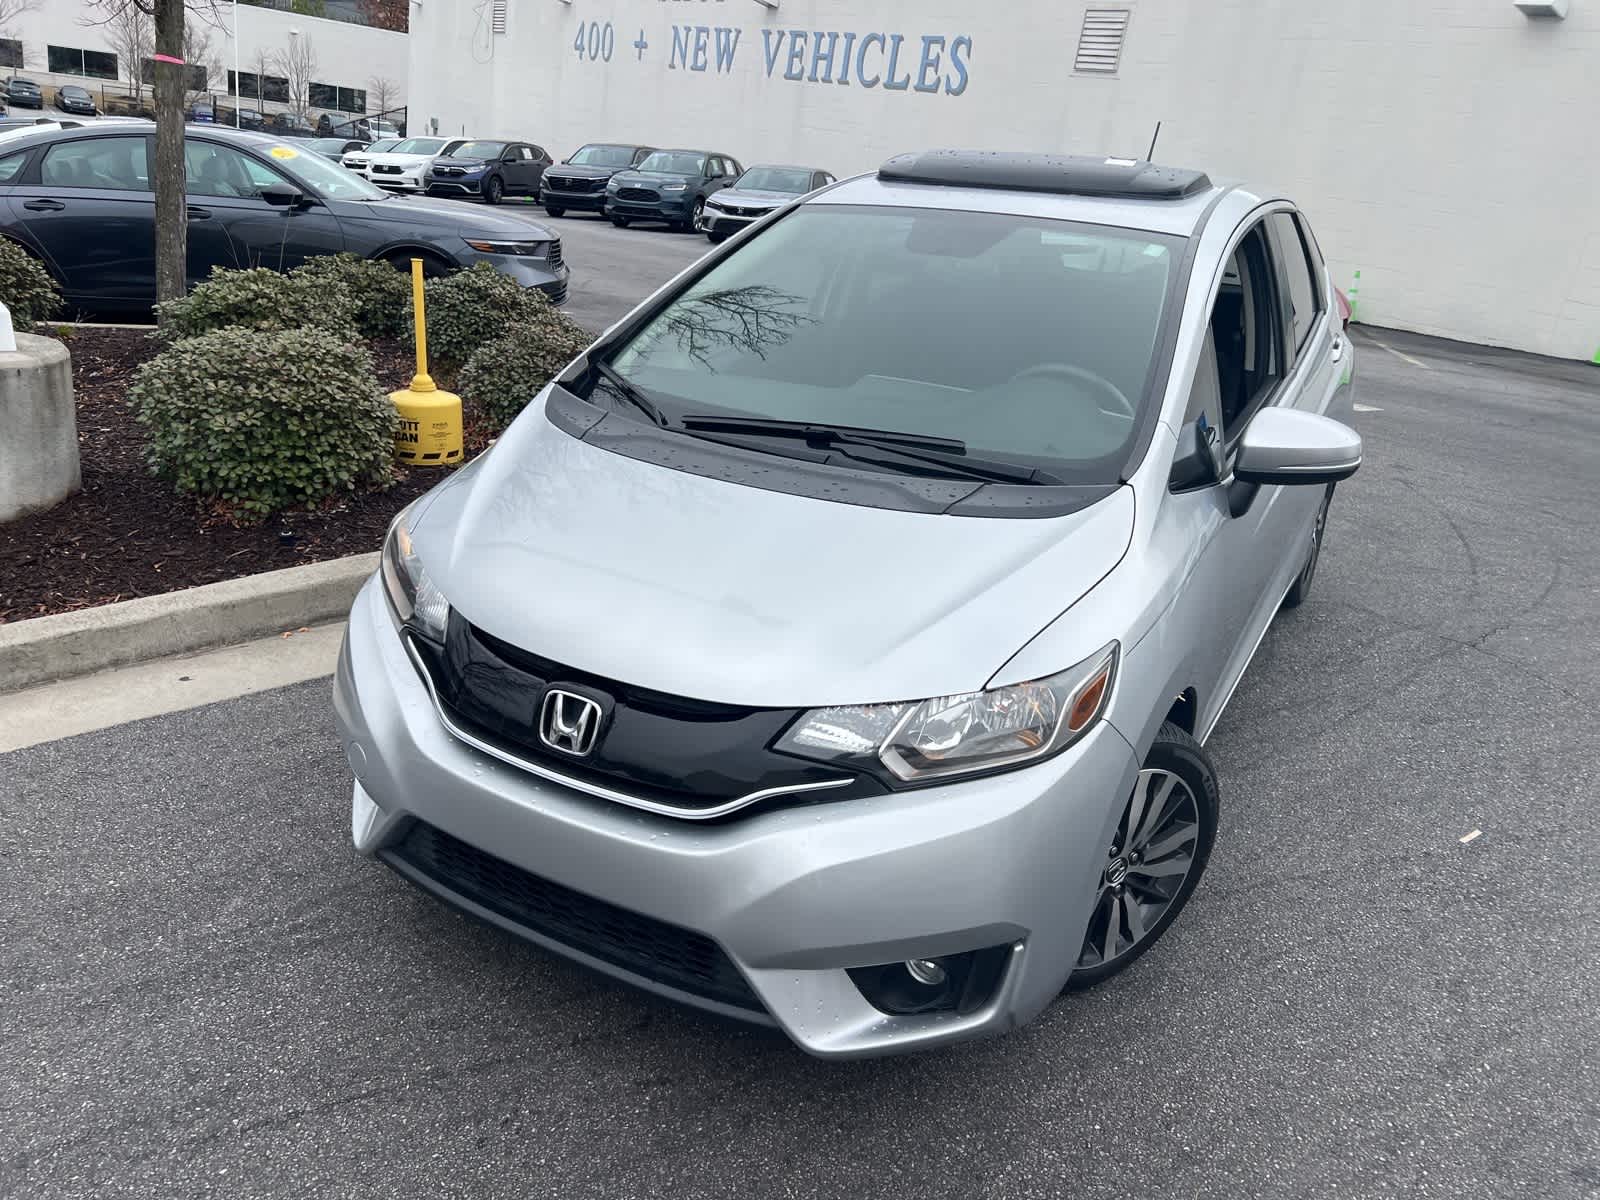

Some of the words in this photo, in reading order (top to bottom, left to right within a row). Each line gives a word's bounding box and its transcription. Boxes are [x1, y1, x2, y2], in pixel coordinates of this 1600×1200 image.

[574, 20, 614, 62] 400
[633, 28, 648, 60] +
[668, 24, 741, 74] NEW
[761, 28, 972, 97] VEHICLES
[399, 420, 420, 431] UTT
[394, 431, 418, 443] CAN
